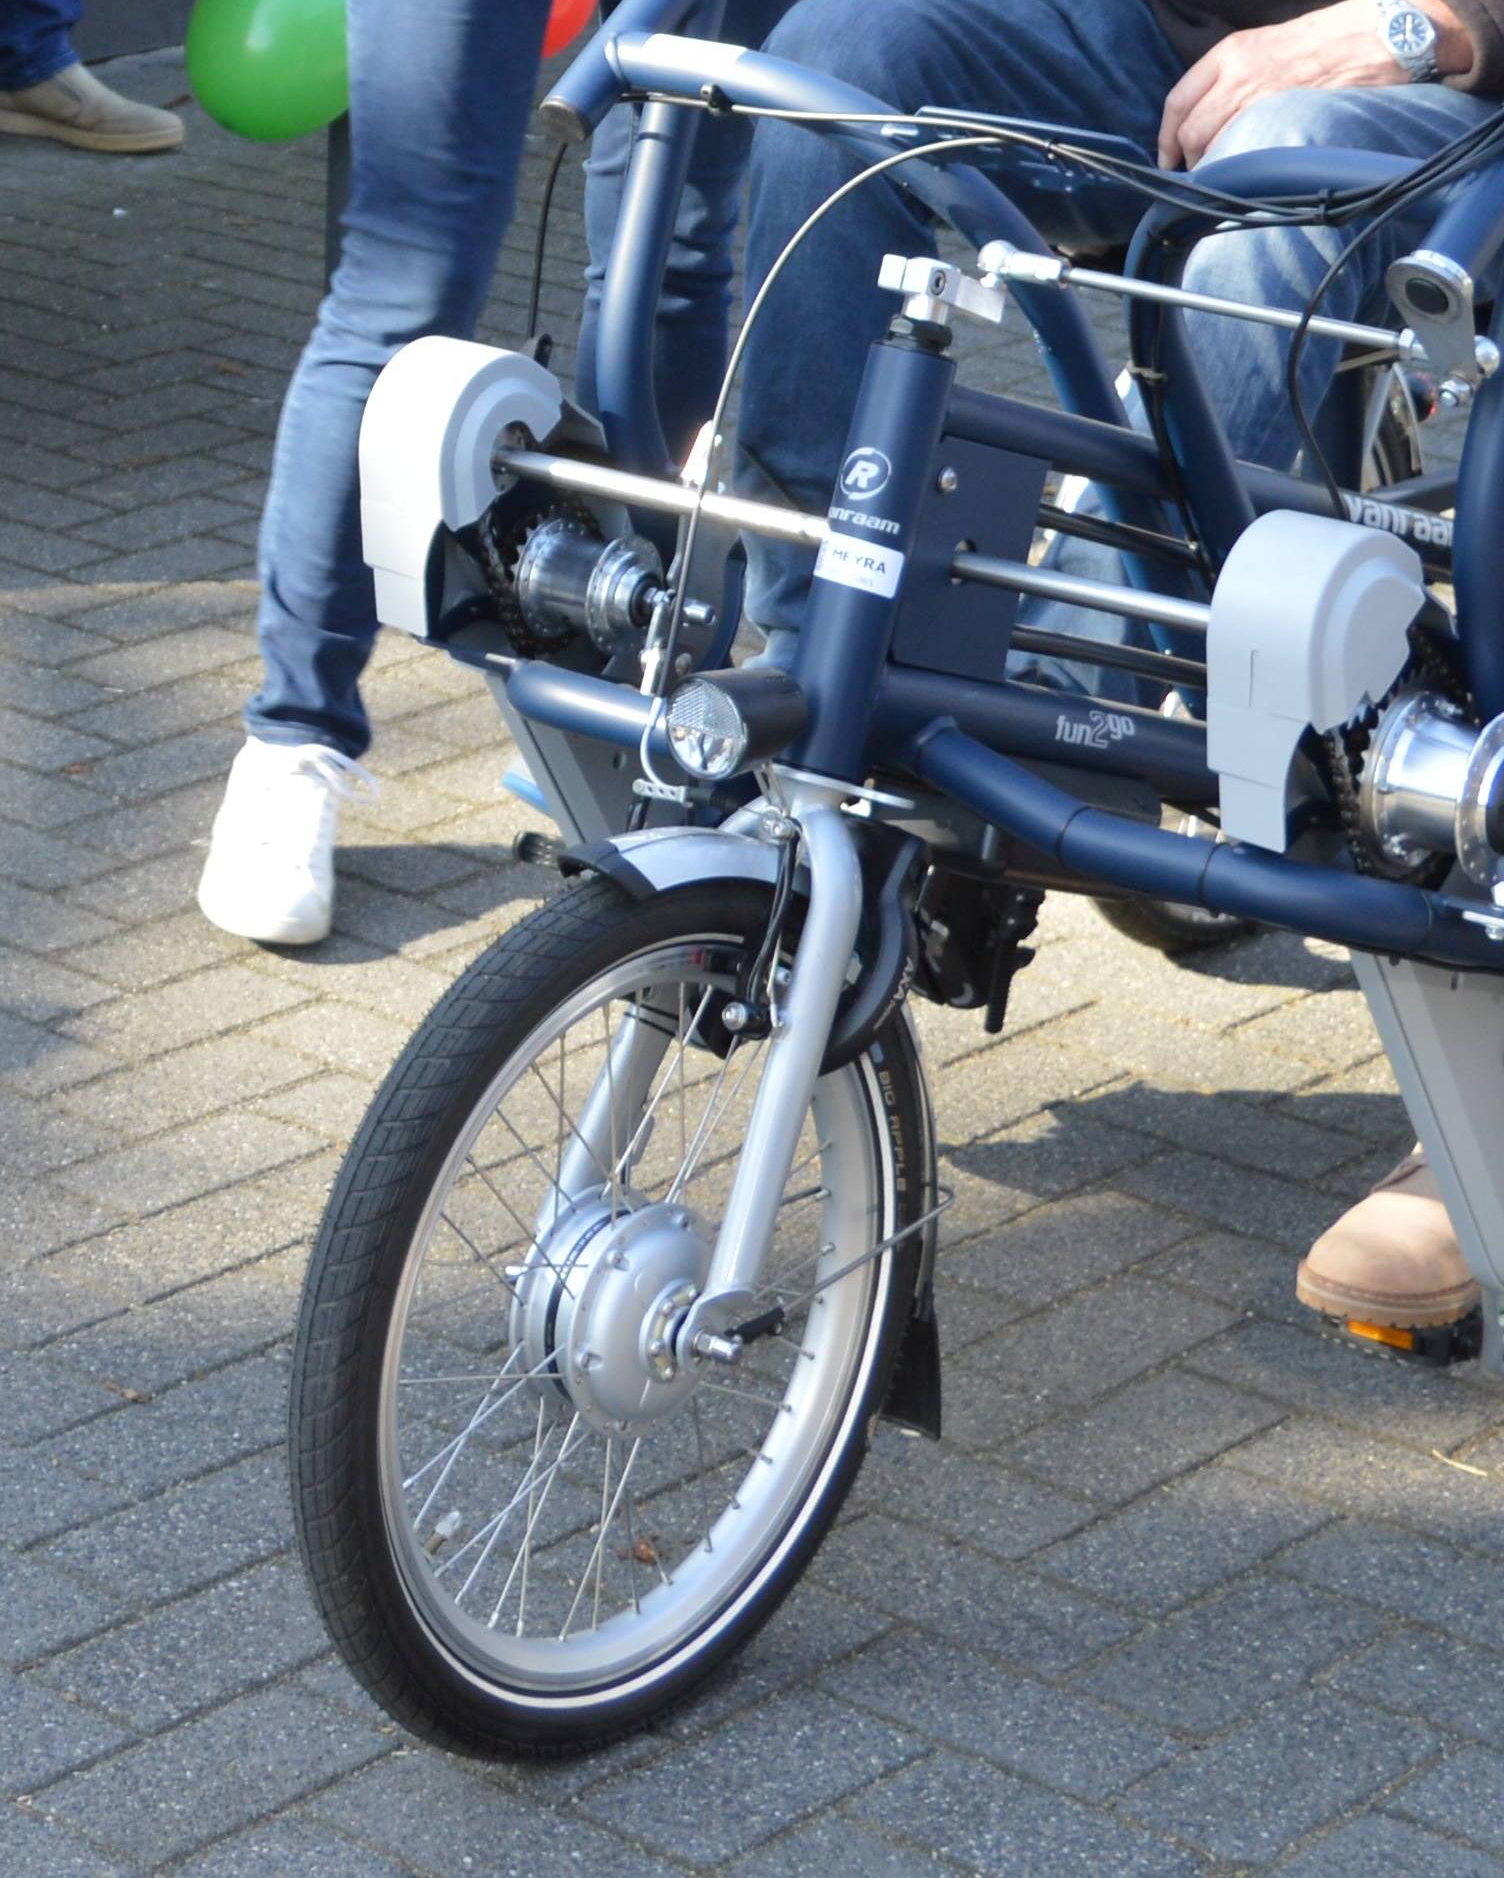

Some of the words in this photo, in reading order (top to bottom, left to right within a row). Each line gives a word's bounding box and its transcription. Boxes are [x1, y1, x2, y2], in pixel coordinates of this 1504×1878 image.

[828, 506, 900, 535] anraam
[1343, 494, 1453, 547] vanraa
[832, 548, 886, 574] MEYRA
[1055, 710, 1136, 749] fun2go
[879, 1071, 896, 1104] BIG
[889, 1114, 907, 1192] APPLE
